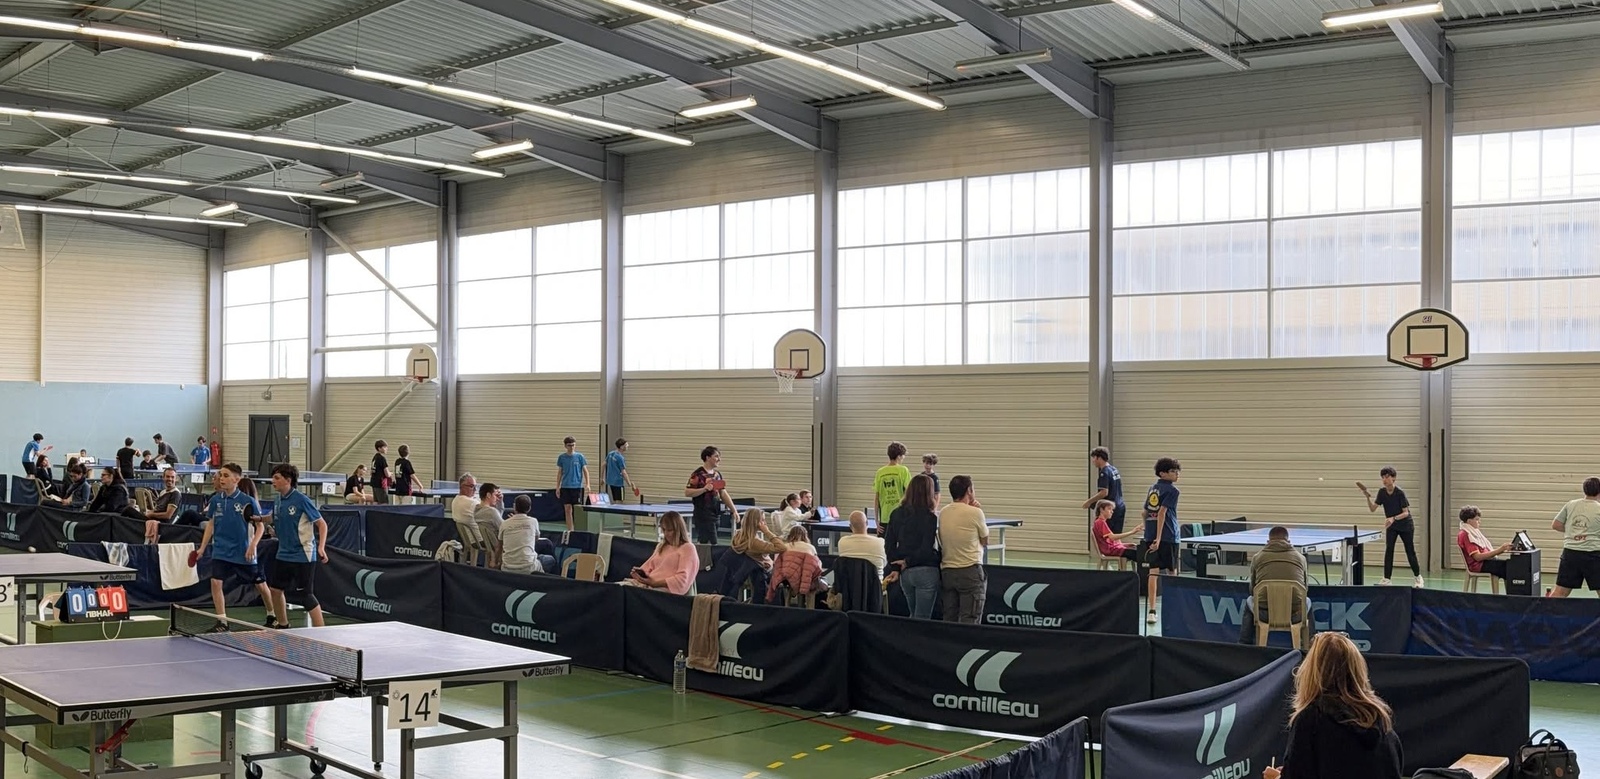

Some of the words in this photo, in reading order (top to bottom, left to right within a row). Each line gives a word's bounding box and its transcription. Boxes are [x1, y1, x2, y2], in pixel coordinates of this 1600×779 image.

[394, 545, 432, 558] cornilleau
[72, 594, 83, 613] 0
[88, 593, 95, 606] 0
[100, 593, 108, 606] 0
[112, 592, 123, 610] 0
[345, 596, 391, 614] cornilleau
[986, 614, 1062, 627] cornilleau
[1199, 595, 1372, 631] WCK
[491, 621, 556, 644] cornilleau
[535, 665, 564, 676] Butterfly
[717, 661, 764, 681] illeau
[90, 708, 132, 721] Butterfly
[399, 692, 431, 722] 14
[933, 693, 1039, 718] cornilleau
